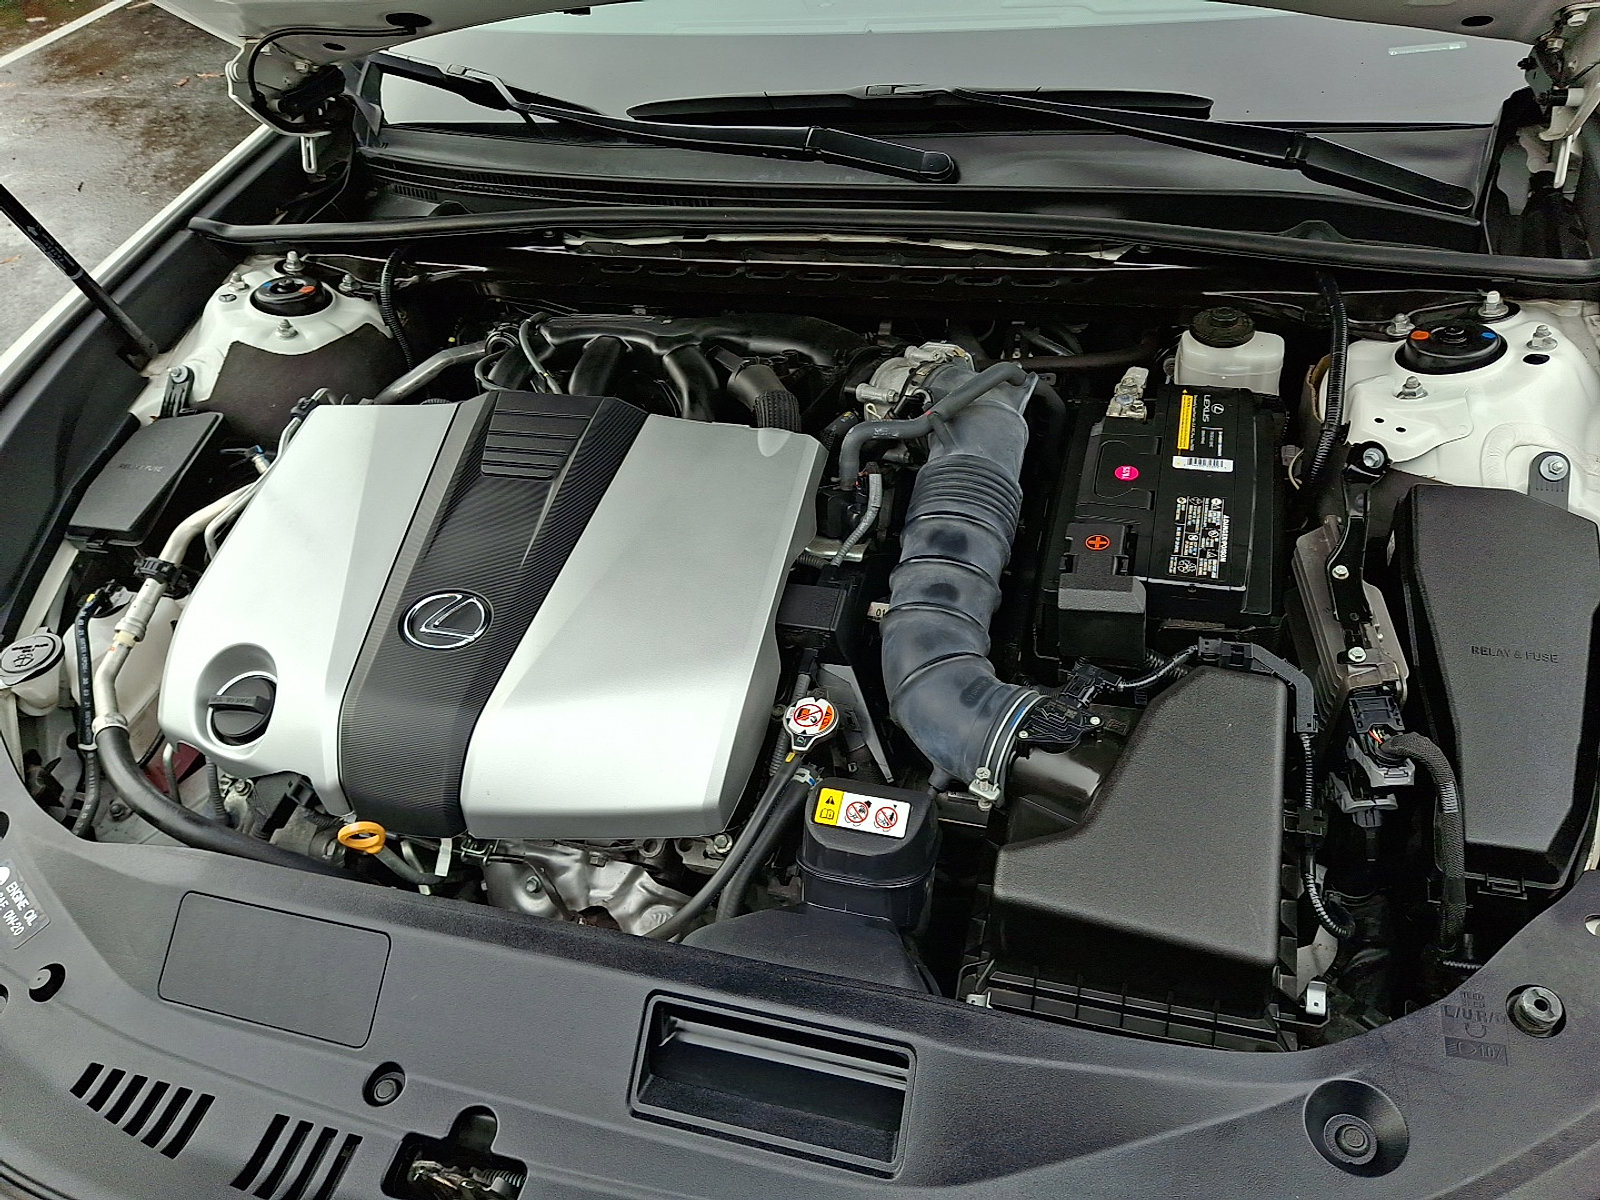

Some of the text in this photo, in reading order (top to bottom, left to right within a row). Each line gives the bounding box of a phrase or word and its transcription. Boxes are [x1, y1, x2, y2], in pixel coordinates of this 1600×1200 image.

[1203, 394, 1211, 423] LEXUS
[1471, 645, 1510, 658] RELAY
[1525, 651, 1559, 663] FUSE
[5, 881, 39, 927] ENGINE OIL
